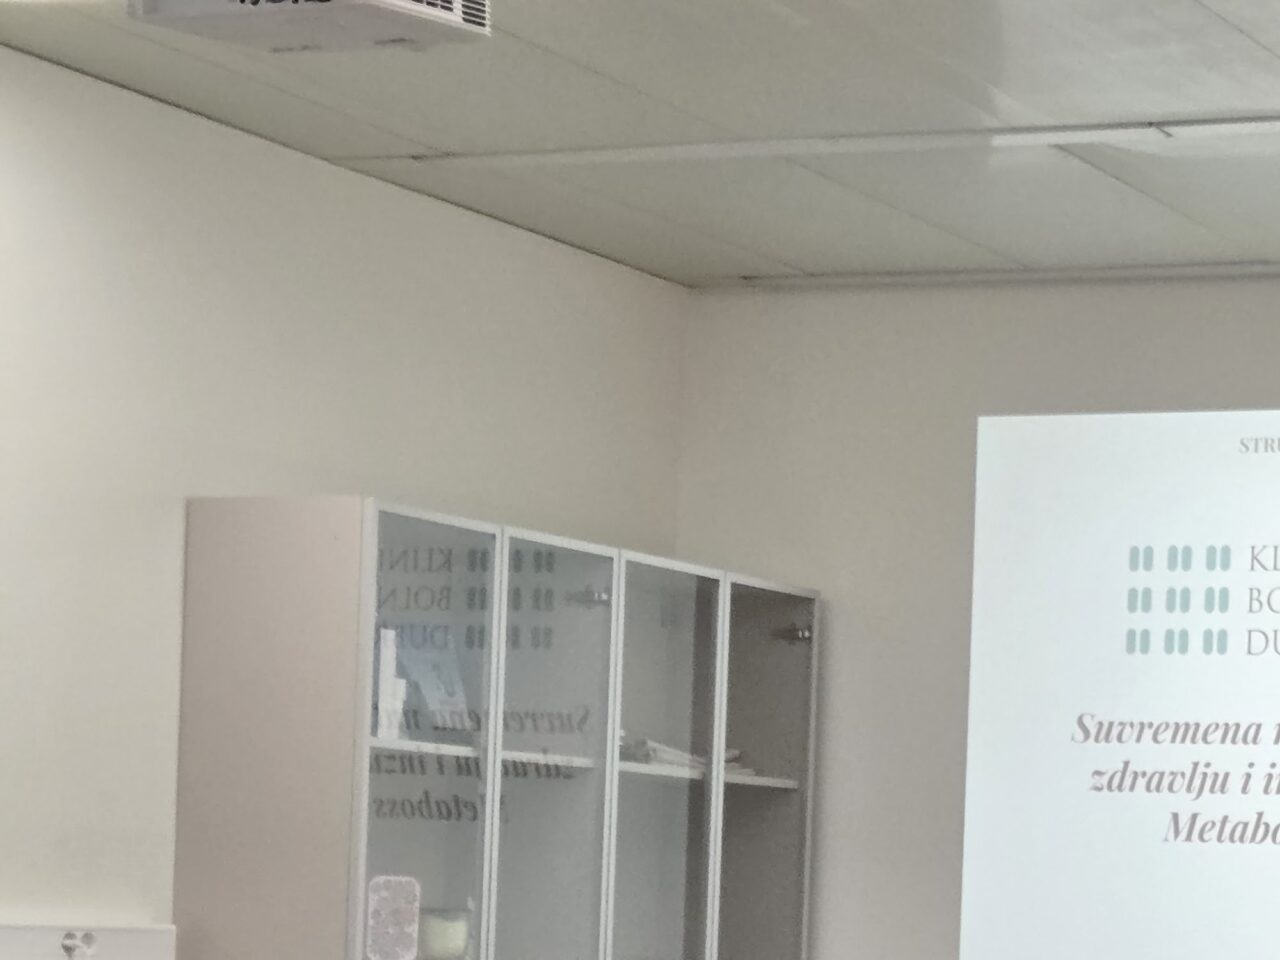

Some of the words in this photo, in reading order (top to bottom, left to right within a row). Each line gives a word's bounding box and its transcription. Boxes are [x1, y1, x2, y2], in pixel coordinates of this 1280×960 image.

[1071, 713, 1263, 746] Suvremena
[1090, 759, 1231, 801] zdravlju
[1240, 761, 1256, 796] i
